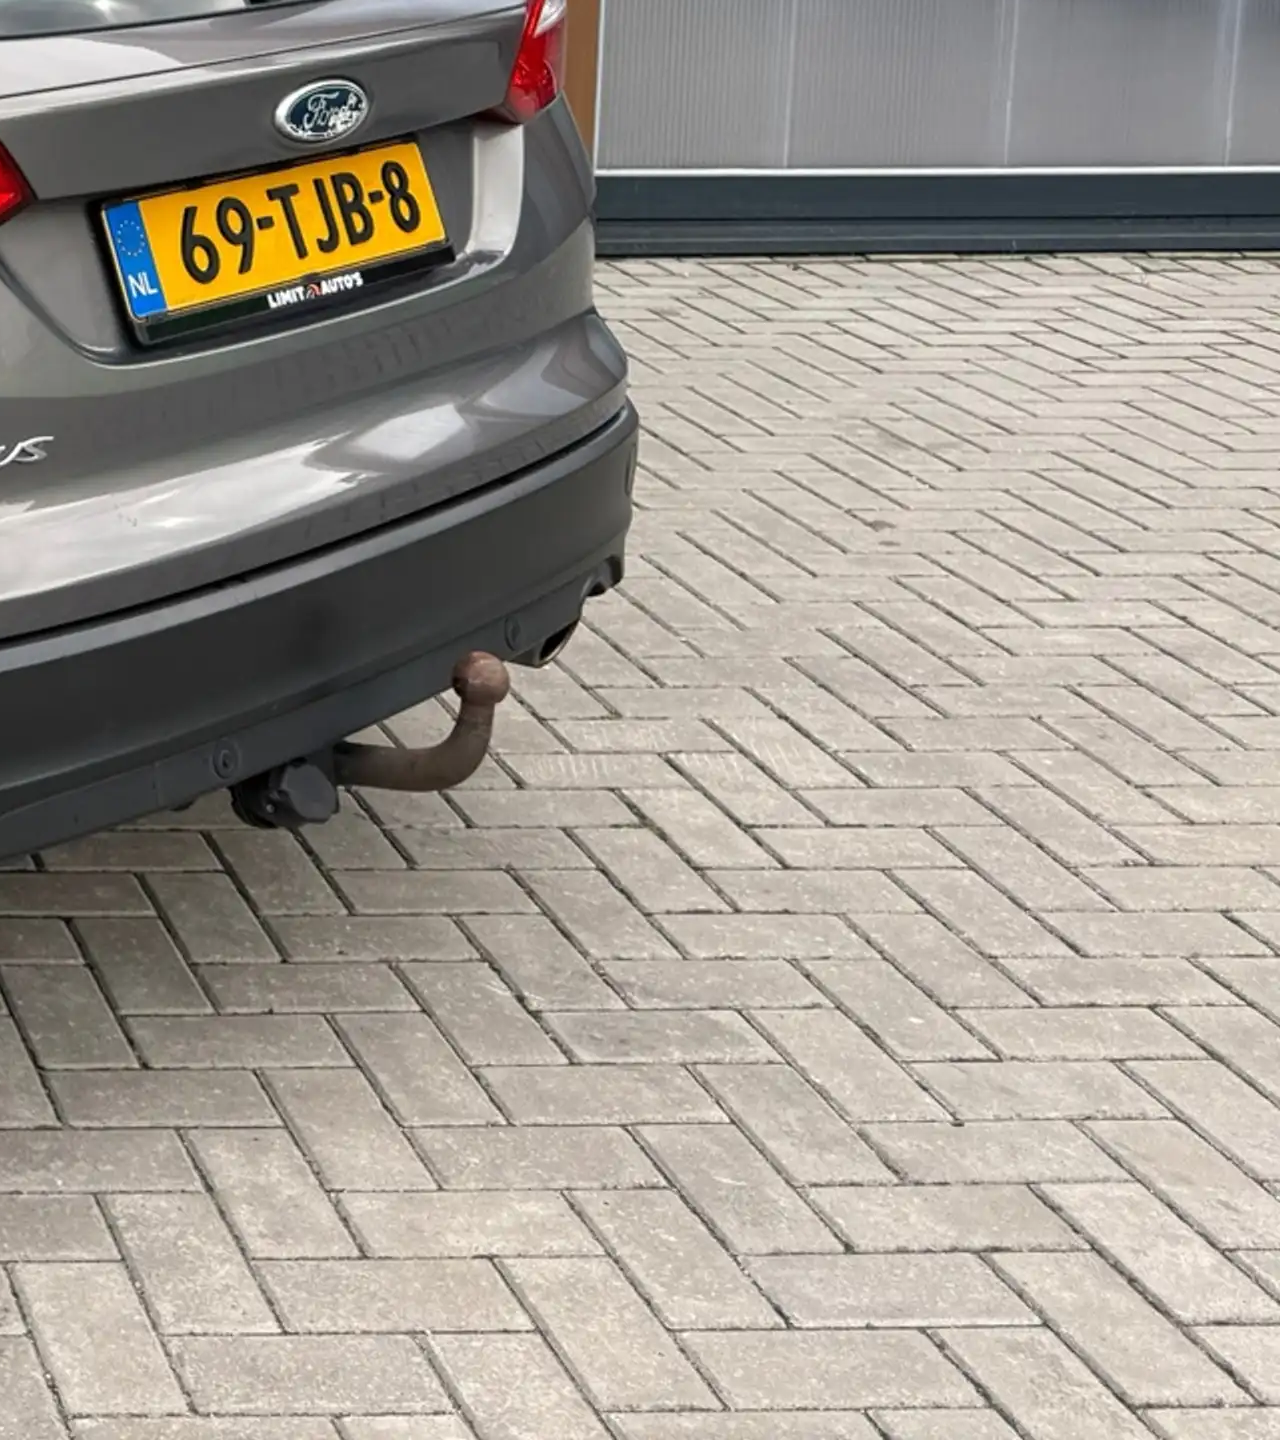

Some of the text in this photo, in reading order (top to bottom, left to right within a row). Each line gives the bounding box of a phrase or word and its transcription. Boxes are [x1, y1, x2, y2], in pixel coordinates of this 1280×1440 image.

[302, 90, 361, 130] Ford
[179, 160, 422, 285] 69-TJB-8
[127, 272, 159, 299] NL
[266, 271, 364, 309] LIMIT AUTO'S
